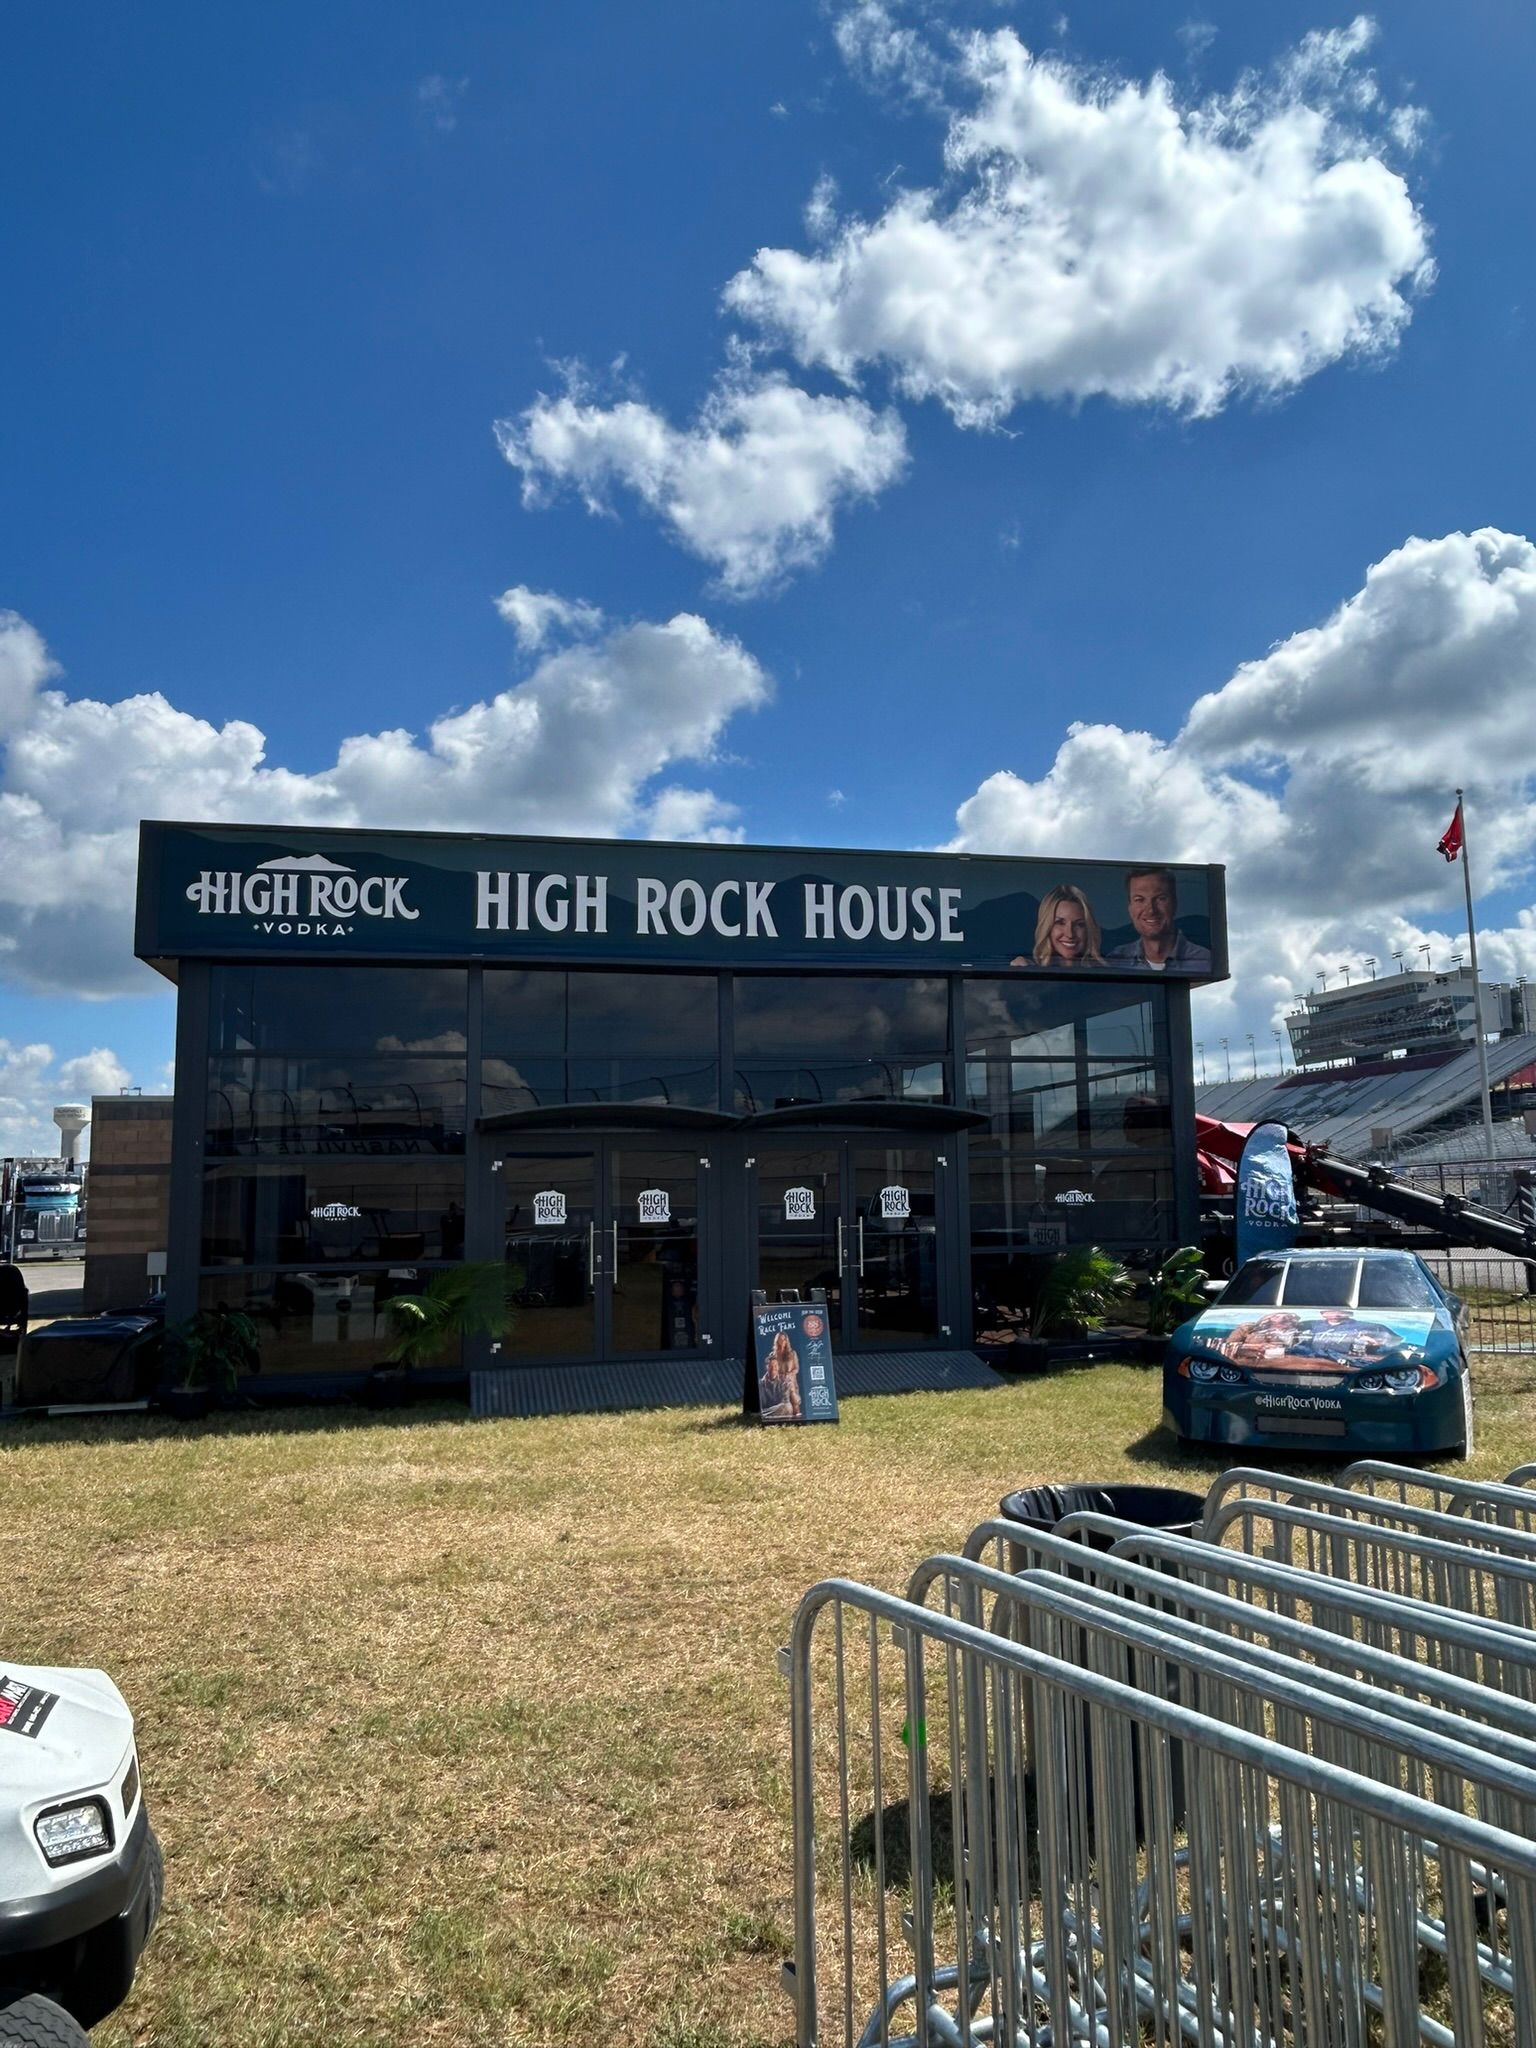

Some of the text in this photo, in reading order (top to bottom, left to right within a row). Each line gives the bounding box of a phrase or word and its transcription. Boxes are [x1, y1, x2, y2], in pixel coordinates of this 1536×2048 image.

[186, 871, 420, 920] HIGH ROCK
[475, 871, 964, 942] HIGH ROCK HOUSE
[263, 922, 347, 936] VODKA
[534, 1195, 563, 1207] HIGH
[638, 1193, 667, 1205] HIGH
[785, 1191, 812, 1203] HIGH
[880, 1190, 907, 1201] HIGH
[1055, 1192, 1096, 1203] HIGH ROCK
[310, 1206, 361, 1218] HIGH ROCK
[538, 1206, 566, 1218] ROCK
[642, 1205, 671, 1217] ROCK
[788, 1202, 815, 1214] ROCK
[884, 1200, 910, 1212] ROCK
